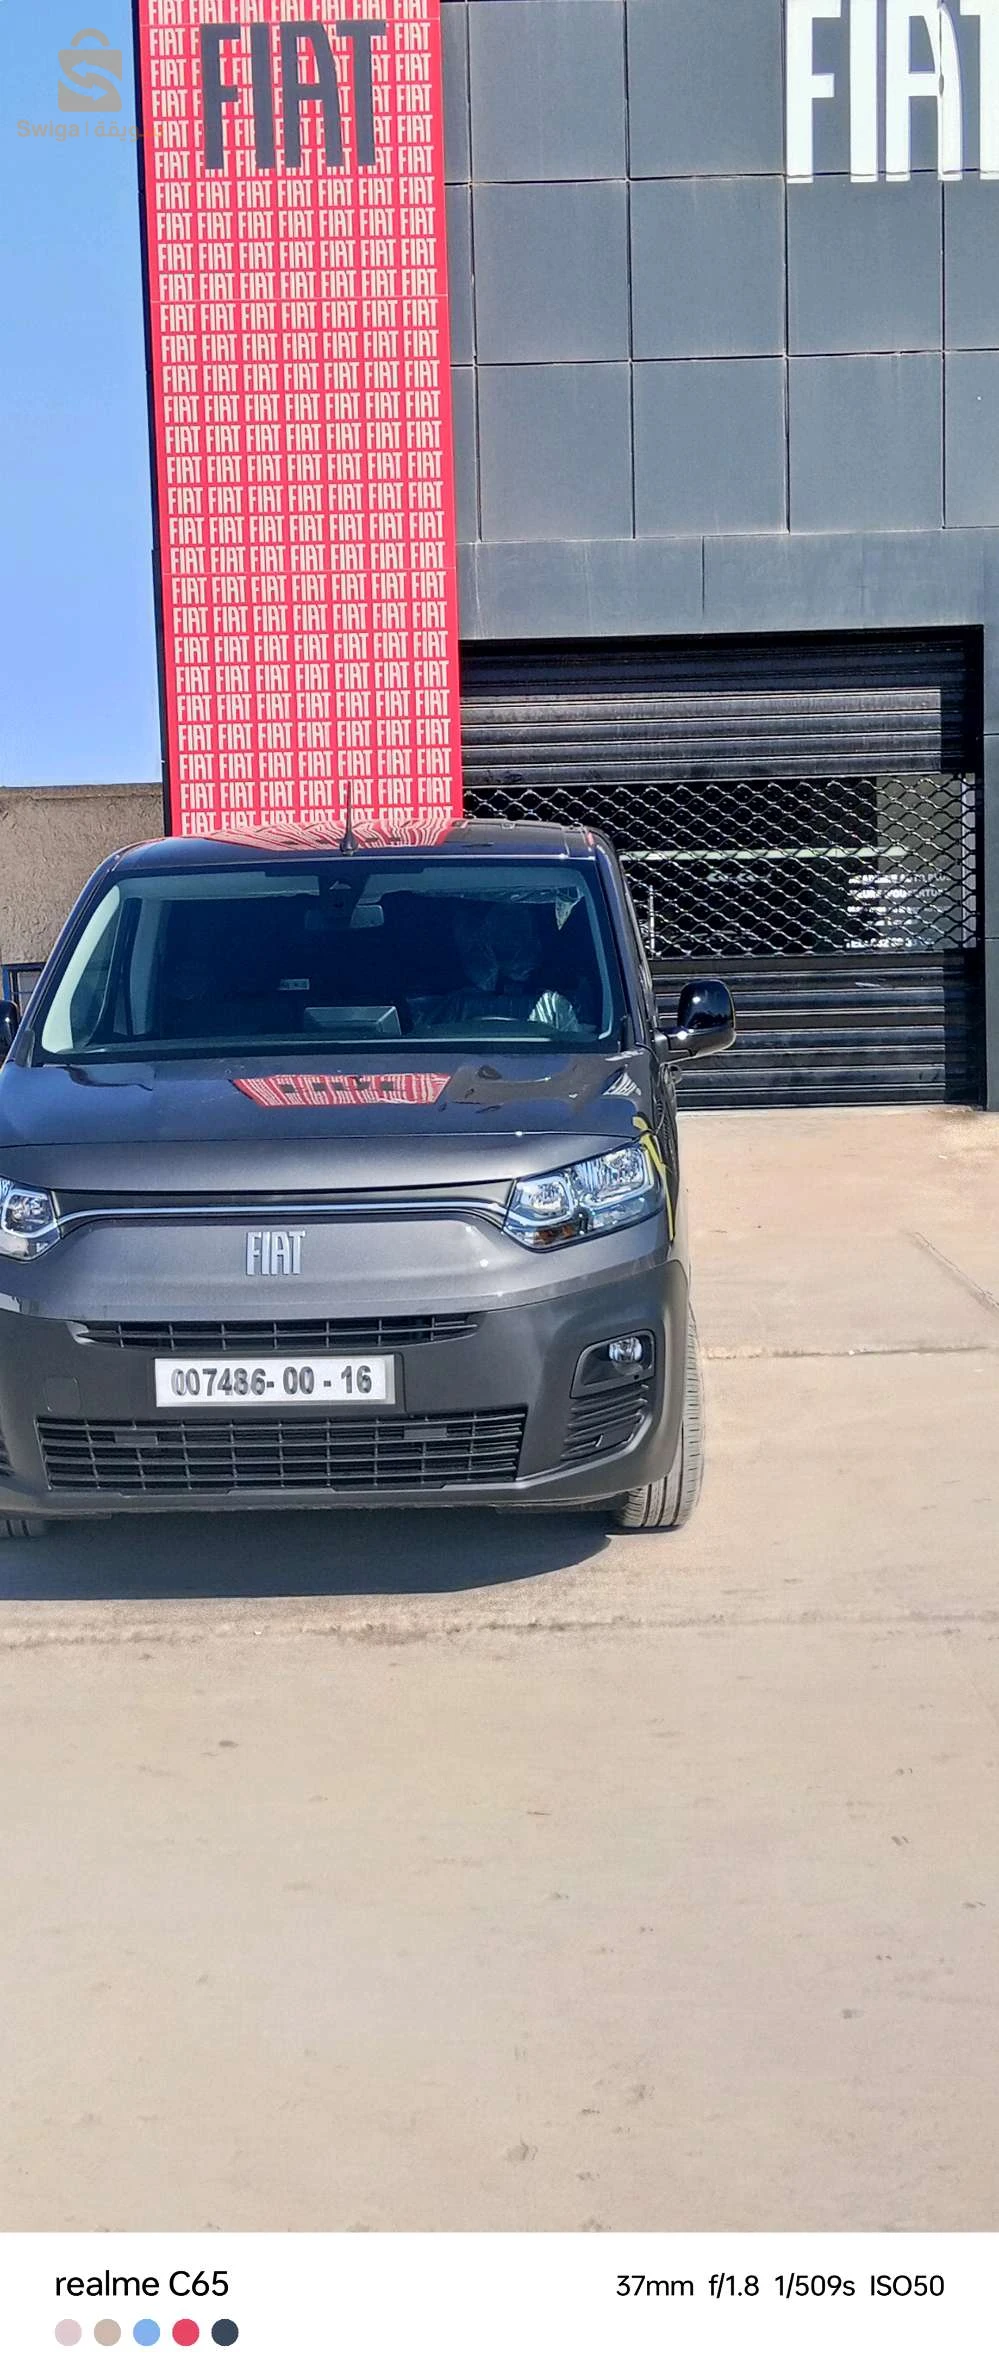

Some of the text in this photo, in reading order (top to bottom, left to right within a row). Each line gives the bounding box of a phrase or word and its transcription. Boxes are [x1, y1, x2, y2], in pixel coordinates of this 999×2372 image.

[148, 0, 428, 26] FIAT FIAT FIAT FIAT FIAT FIAT FIAT
[149, 22, 431, 57] FIAT FIAT
[150, 52, 432, 88] FIAT FIAT
[151, 83, 433, 118] FIAT FIAT
[200, 20, 386, 169] FIAT
[153, 114, 433, 149] FIAT FIAT
[154, 145, 434, 180] FIAT FIAT
[155, 175, 435, 210] FIAT FIAT FIAT FIAT FIAT FIAT FIAT
[156, 206, 436, 241] FIAT FIAT FIAT FIAT FIAT FIAT FIAT
[159, 268, 438, 302] FIAT FIAT FIAT FIAT FIAT FIAT FIAT
[160, 298, 439, 332] FIAT FIAT FIAT FIAT FIAT FIAT FIAT
[161, 329, 439, 363] FIAT FIAT FIAT FIAT FIAT FIAT FIAT
[163, 390, 441, 423] FIAT FIAT FIAT FIAT FIAT FIAT FIAT
[165, 420, 442, 454] FIAT FIAT FIAT FIAT FIAT FIAT FIAT
[166, 450, 443, 484] FIAT FIAT FIAT FIAT FIAT FIAT FIAT
[167, 483, 364, 515] FIAT FIAT FIAT FIAT FIAT
[169, 510, 445, 545] FIAT FIAT FIAT FIAT FIAT FIAT FIAT
[170, 541, 446, 575] FIAT FIAT FIAT FIAT FIAT FIAT FIAT
[171, 570, 447, 605] FIAT FIAT FIAT FIAT FIAT FIAT FIAT
[174, 630, 449, 664] FIAT FIAT FIAT FIAT FIAT FIAT FIAT
[175, 660, 450, 693] FIAT FIAT FIAT FIAT FIAT FIAT FIAT
[176, 689, 450, 722] FIAT FIAT FIAT FIAT FIAT FIAT FIAT
[179, 747, 452, 781] FIAT FIAT FIAT FIAT FIAT FIAT FIAT
[180, 776, 453, 810] FIAT FIAT FIAT FIAT FIAT FIAT
[181, 811, 217, 837] FIAT
[246, 1231, 305, 1275] FIAT
[341, 1365, 372, 1393] 16
